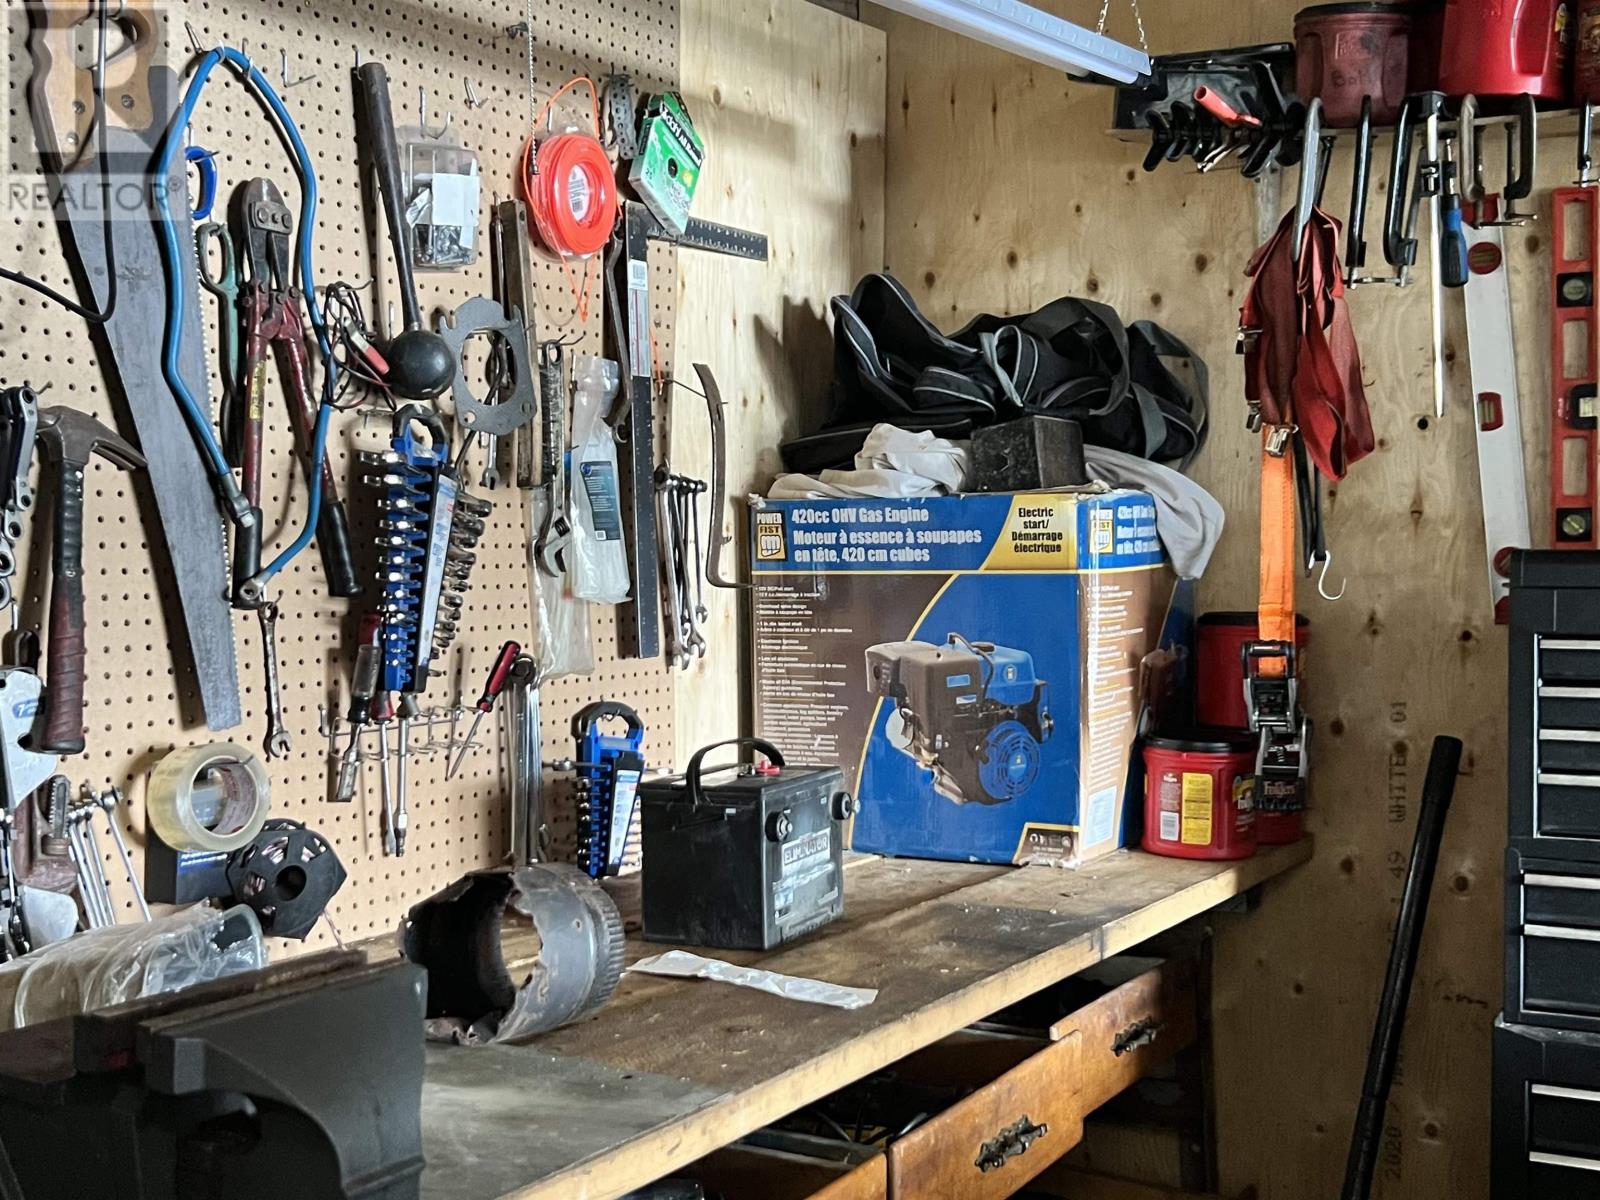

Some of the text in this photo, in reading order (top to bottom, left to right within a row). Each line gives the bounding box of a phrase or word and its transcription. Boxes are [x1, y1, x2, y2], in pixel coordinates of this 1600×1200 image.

[757, 513, 782, 524] POWER
[792, 507, 929, 524] 420cc OHV Gas Engine
[1018, 507, 1054, 518] Electric
[1023, 519, 1049, 529] start/
[793, 528, 982, 545] Moteur à essence à soupapes
[1011, 531, 1063, 542] Démarrage
[1014, 541, 1062, 554] électrique
[794, 547, 930, 564] en tête, 420 cm cubes
[1389, 753, 1407, 823] WHITE
[1388, 851, 1406, 879] 49
